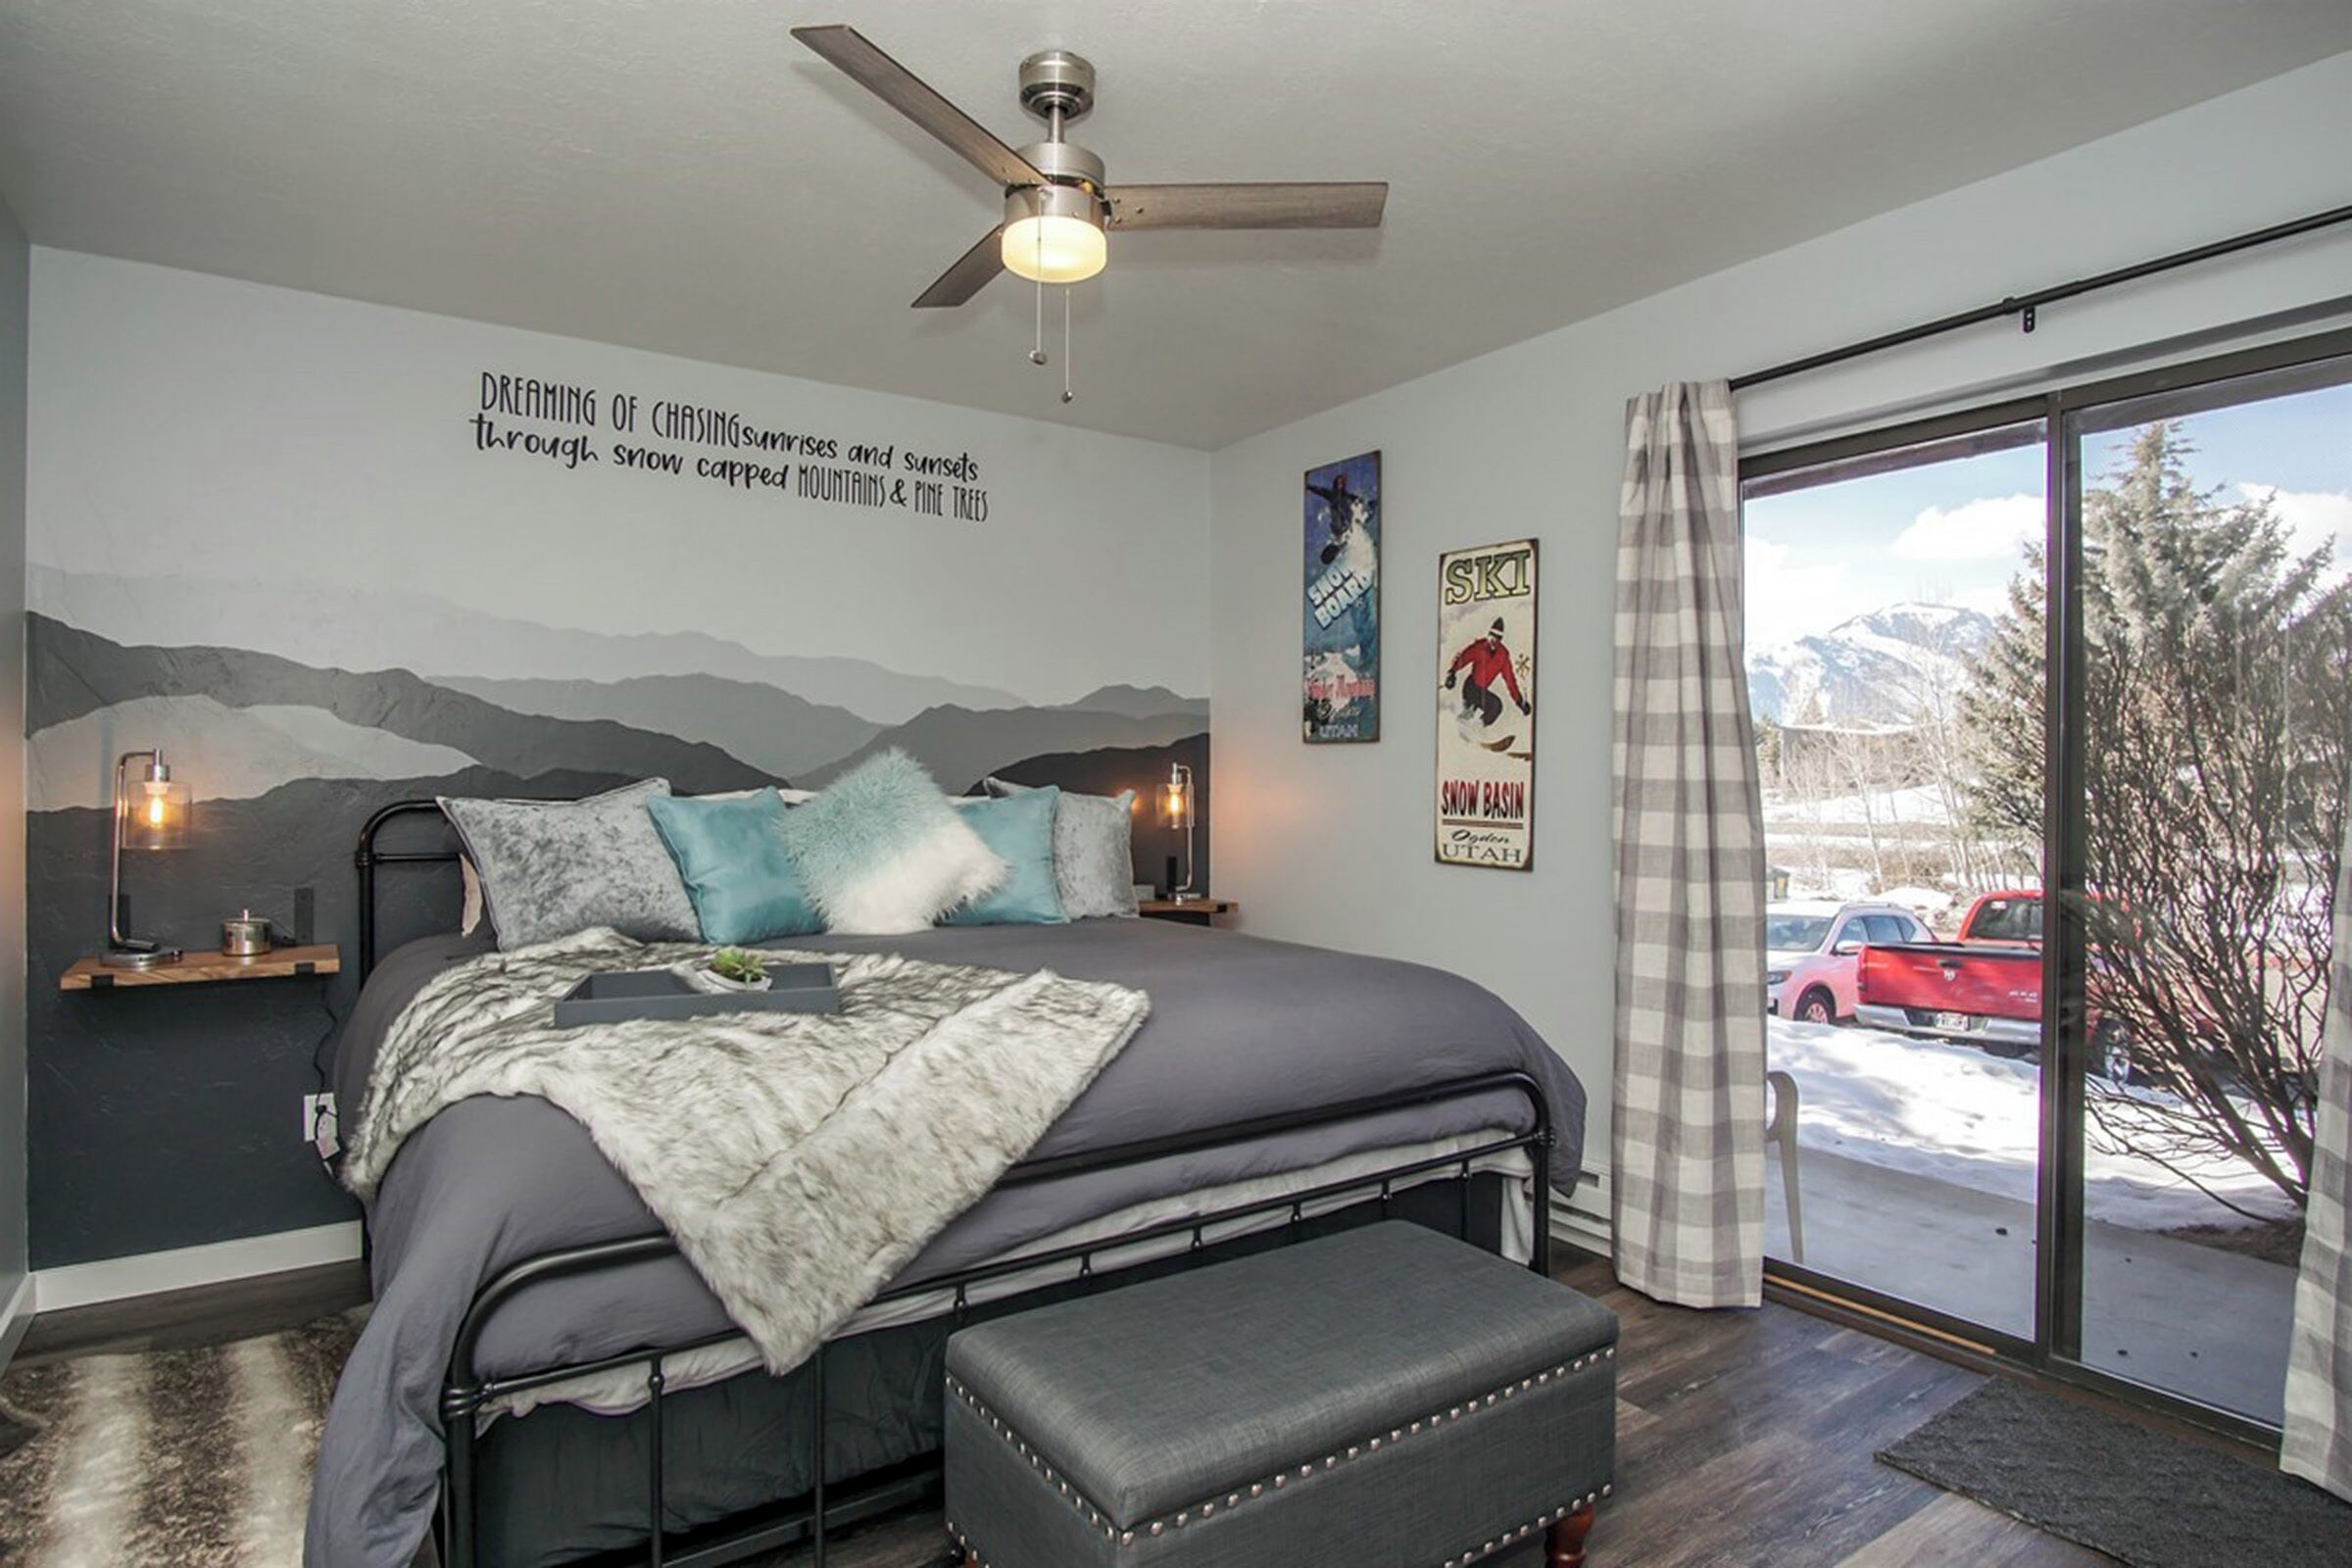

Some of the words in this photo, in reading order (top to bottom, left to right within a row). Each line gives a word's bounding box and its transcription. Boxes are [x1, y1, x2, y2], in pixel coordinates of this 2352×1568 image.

[481, 371, 596, 426] DREAMING
[612, 393, 637, 432] OF
[652, 401, 739, 448] CHASING
[742, 425, 838, 460] sunrises
[848, 444, 894, 469] and
[905, 452, 978, 483] sunsets
[468, 412, 599, 469] through
[613, 444, 683, 474] snow
[697, 457, 789, 489] capped
[799, 465, 886, 508] MOUNTAINS
[890, 478, 907, 508] &
[914, 480, 944, 516] PINE
[953, 485, 988, 522] TREES
[1314, 568, 1373, 629] BOARD
[1446, 549, 1531, 605] SKI
[1442, 780, 1479, 815] SNOW
[1484, 781, 1524, 818] BASIN
[1444, 844, 1521, 862] UTAH
